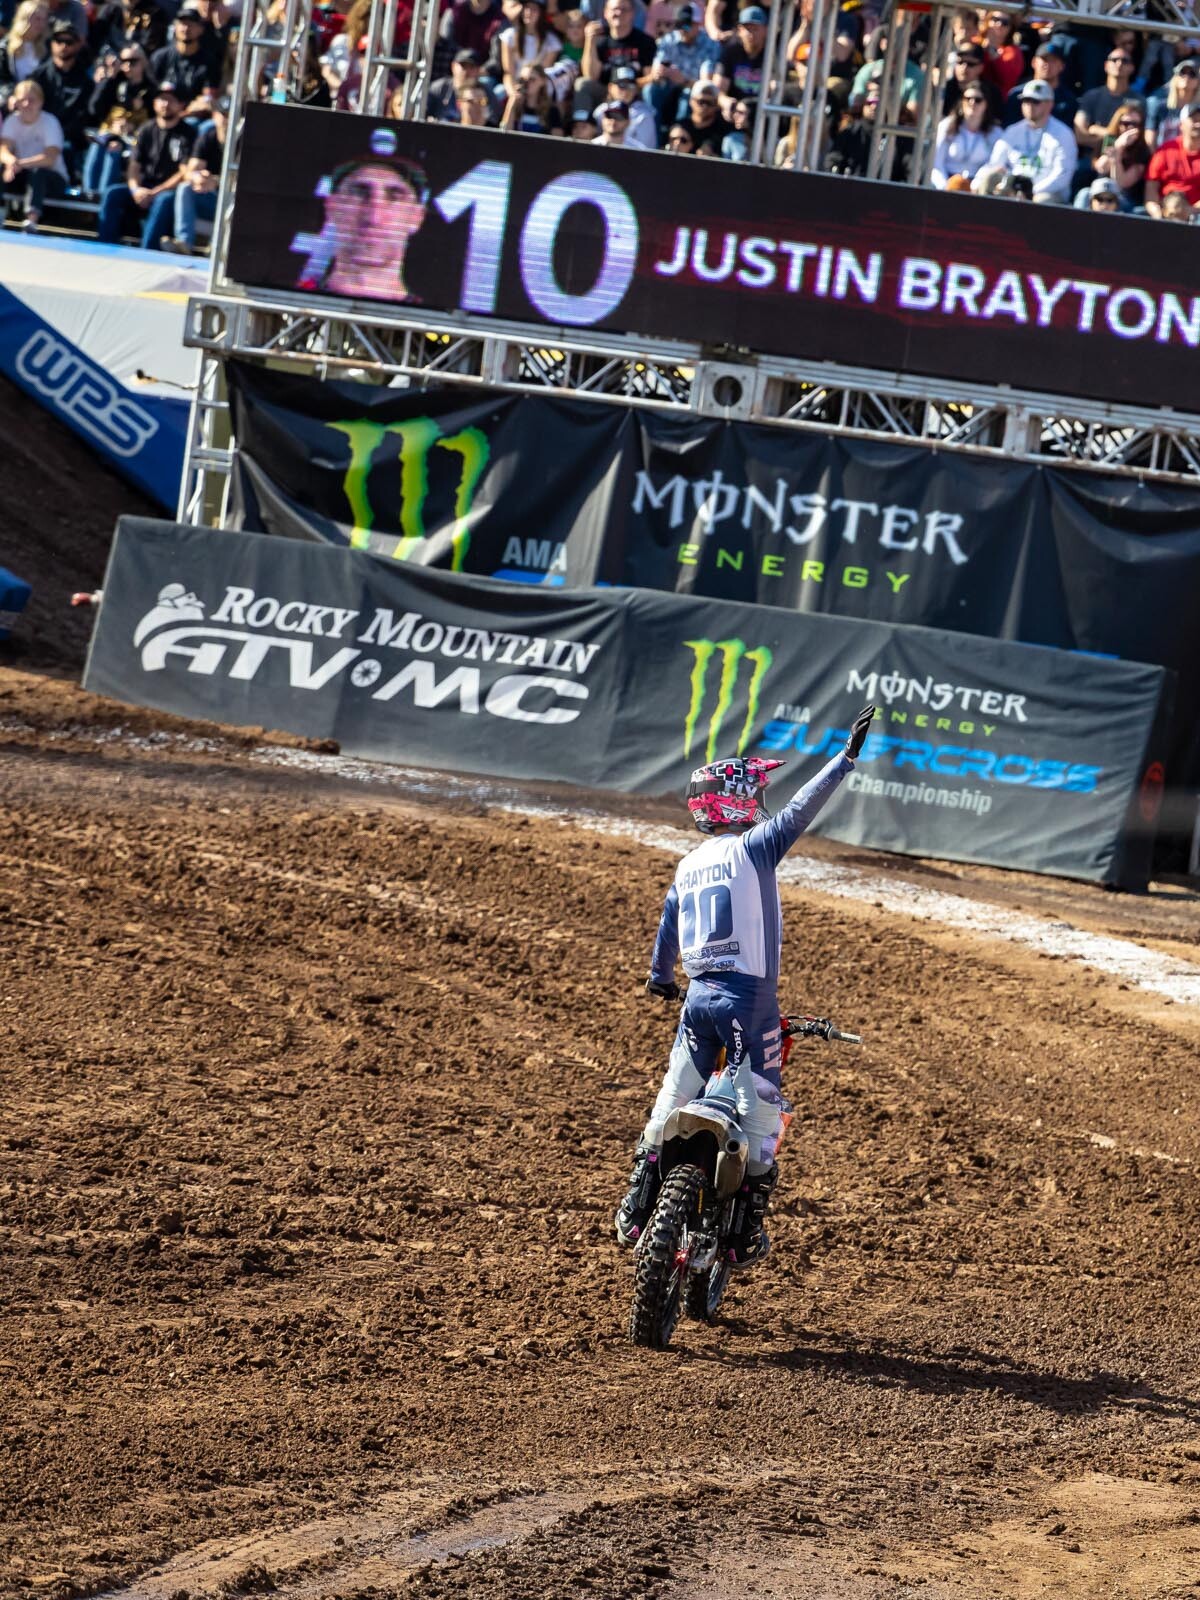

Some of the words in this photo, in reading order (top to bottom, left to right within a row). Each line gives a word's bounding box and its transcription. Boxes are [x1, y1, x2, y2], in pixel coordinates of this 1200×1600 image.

[654, 226, 884, 303] JUSTIN
[631, 469, 969, 566] MONSTER
[501, 535, 567, 572] AMA
[677, 543, 911, 593] ENERGY
[210, 585, 358, 638] ROCKY
[358, 609, 601, 675] MOUNTAIN
[773, 703, 811, 725] AMA
[846, 669, 1028, 722] MONSTER
[873, 706, 998, 737] ENERGY
[847, 771, 993, 816] Championship
[681, 884, 734, 950] 10
[733, 1031, 744, 1065] HODA
